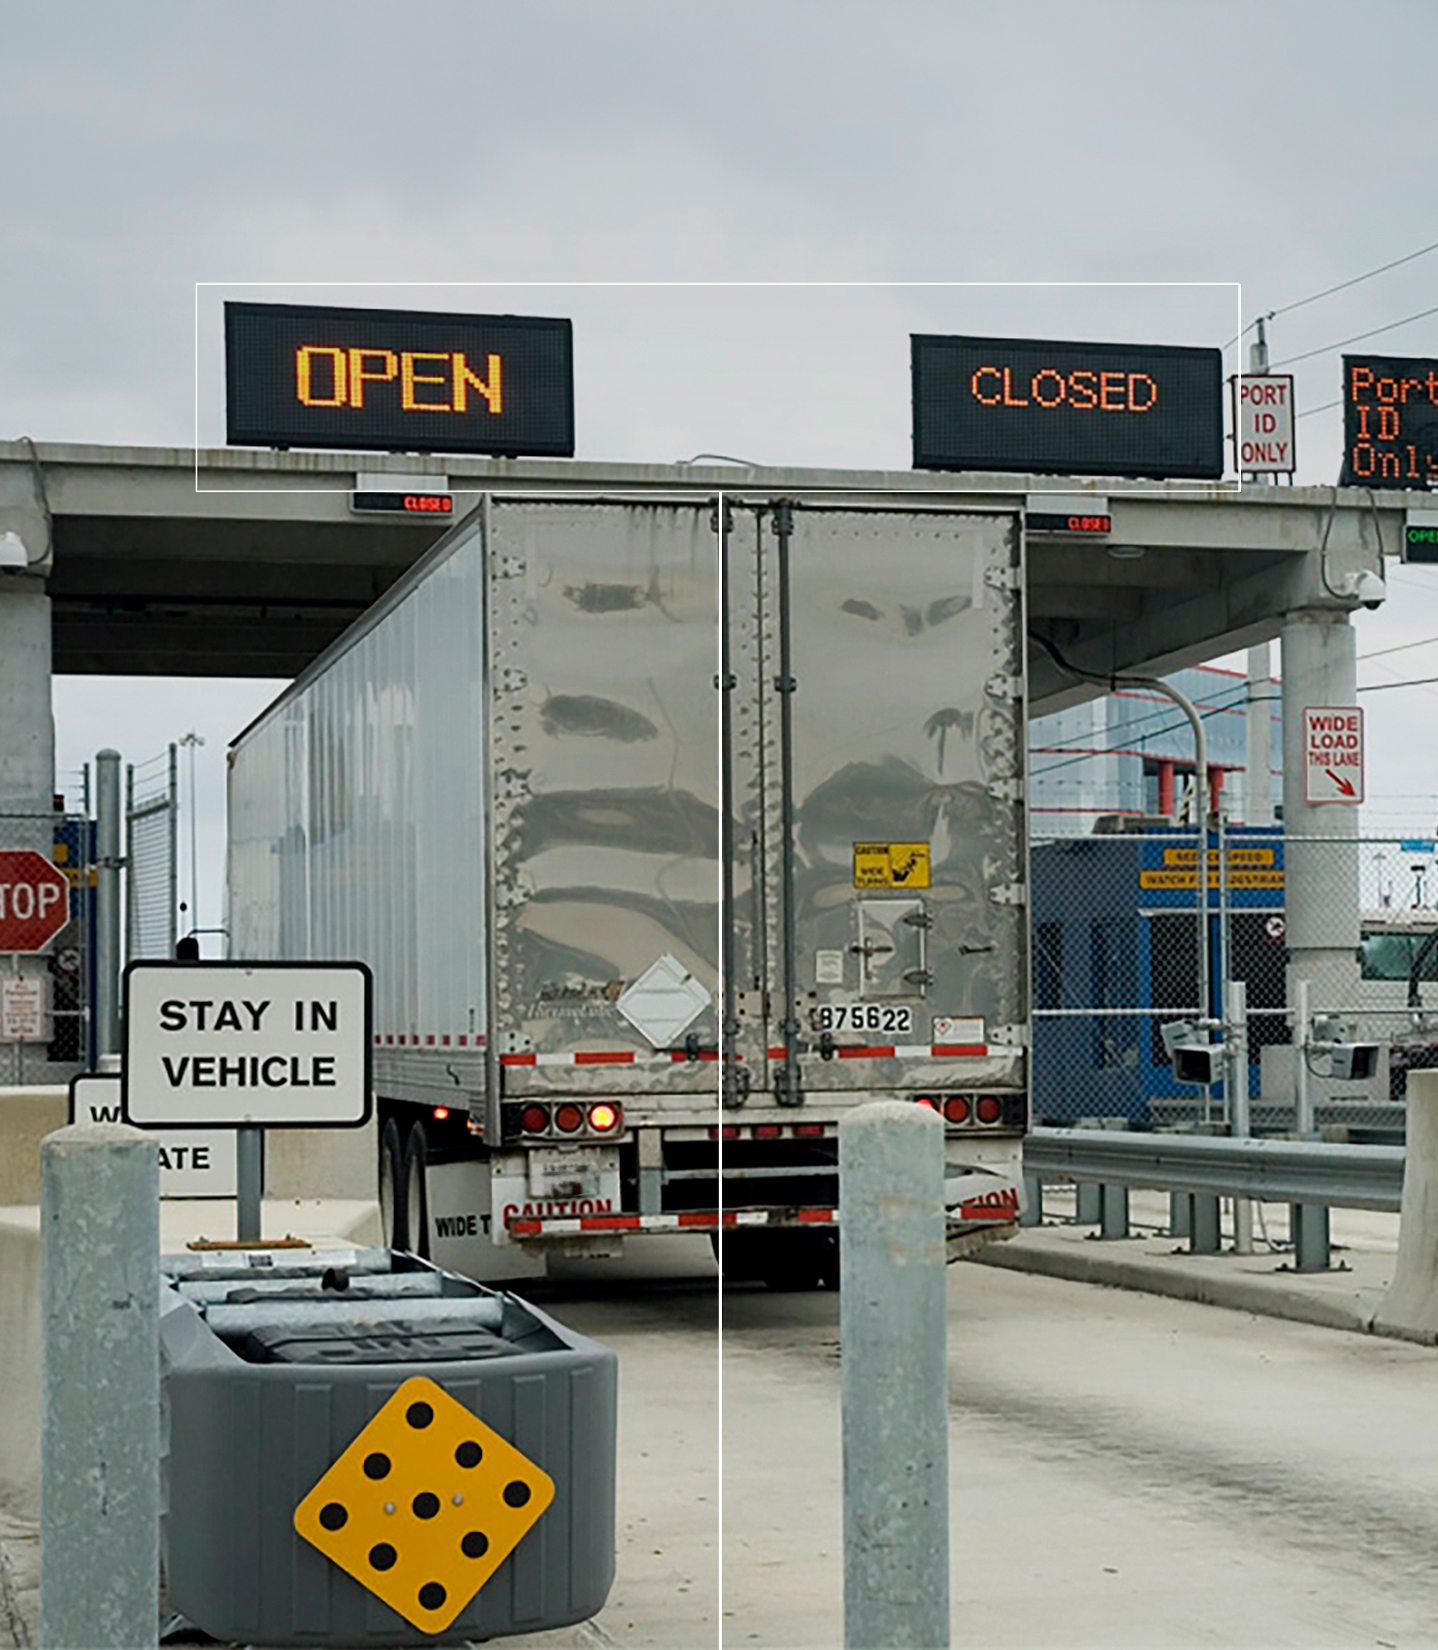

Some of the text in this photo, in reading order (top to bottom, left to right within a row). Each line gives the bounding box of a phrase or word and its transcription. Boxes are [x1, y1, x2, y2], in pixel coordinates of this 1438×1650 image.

[296, 345, 502, 415] OPEN
[971, 366, 1157, 412] CLOSED
[1352, 367, 1438, 406] Port
[1240, 385, 1287, 405] PORT
[1255, 413, 1277, 433] ID
[1357, 406, 1399, 440] ID
[1241, 443, 1288, 463] ONLY
[404, 495, 452, 511] CLOSED
[1406, 529, 1438, 543] OPE
[1309, 716, 1358, 731] WIDE
[1311, 734, 1358, 749] LOAD
[1309, 752, 1359, 766] THIS LANE
[0, 883, 60, 919] TOP
[159, 1000, 337, 1031] STAY IN
[162, 1056, 336, 1087] VEHICLE
[158, 1147, 210, 1169] ATE
[435, 1215, 477, 1238] WIDE
